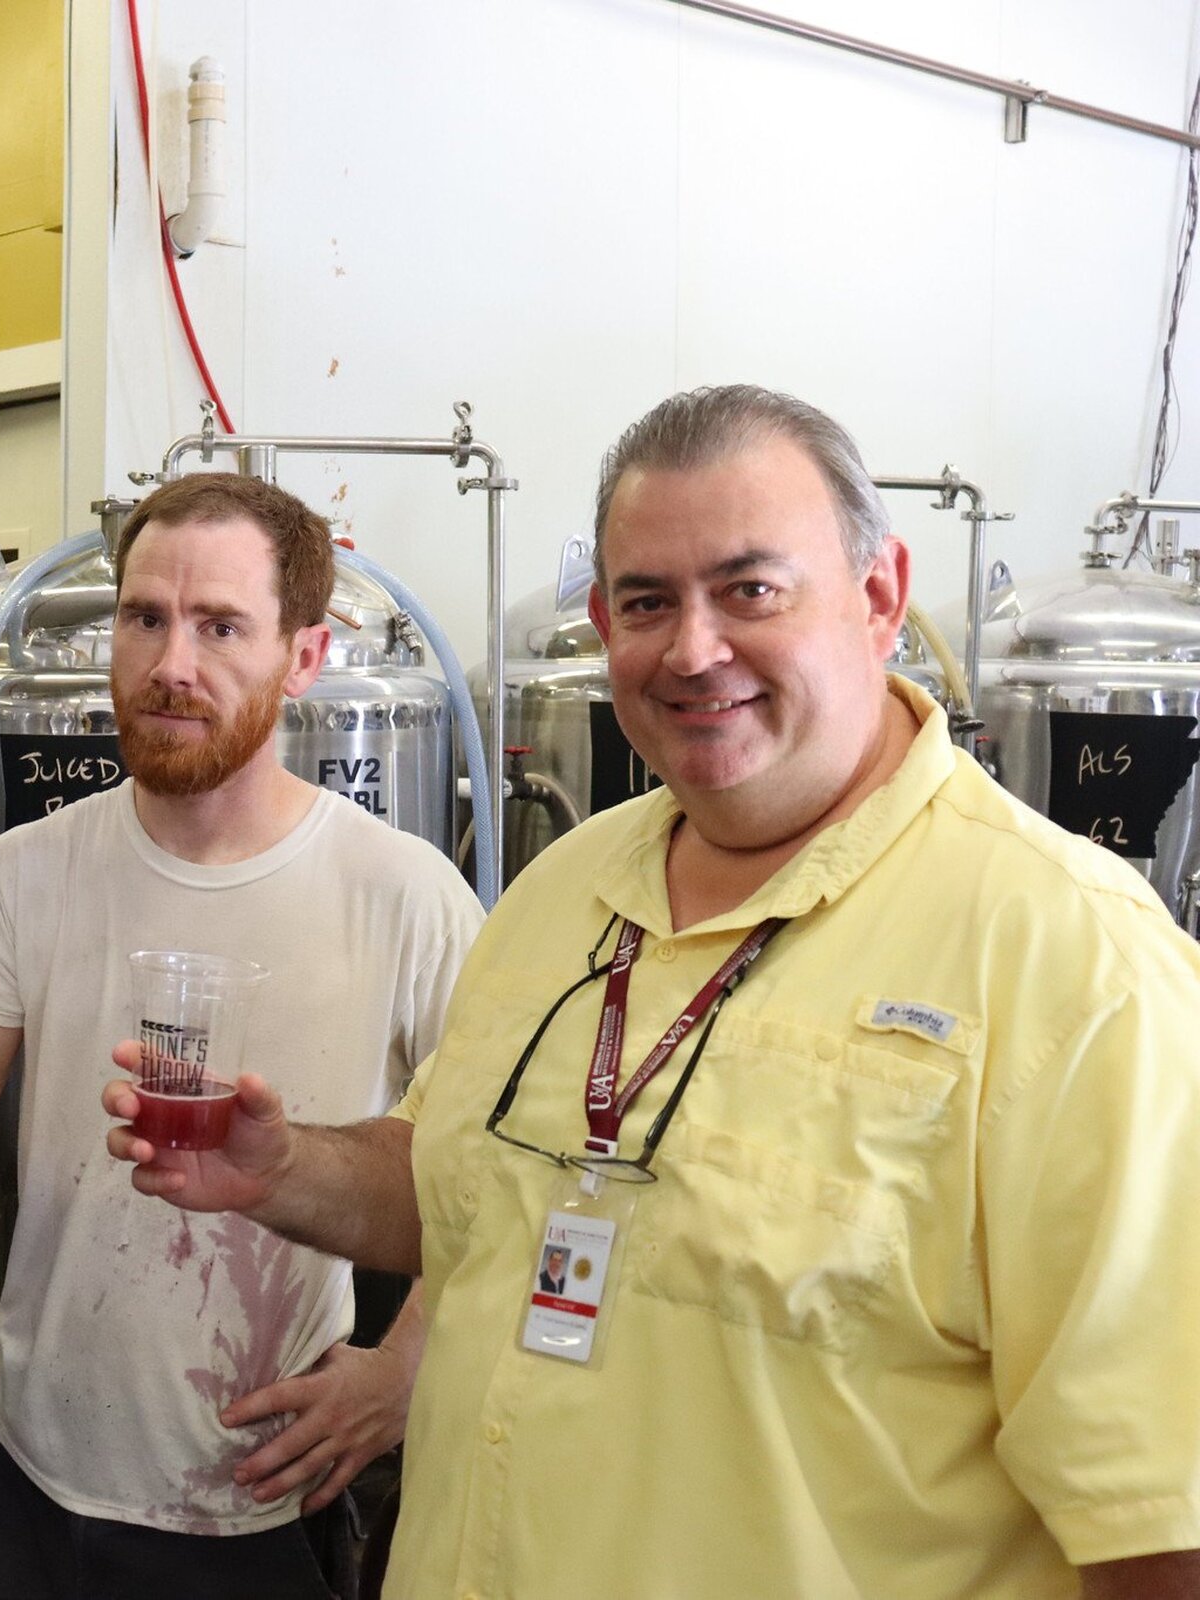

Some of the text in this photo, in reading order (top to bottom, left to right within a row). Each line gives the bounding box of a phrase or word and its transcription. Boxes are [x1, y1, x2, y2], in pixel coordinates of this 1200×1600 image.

[19, 751, 120, 785] JUICED
[318, 758, 381, 785] FV2
[338, 790, 387, 815] BL
[140, 1029, 208, 1063] STONE'S
[141, 1055, 205, 1092] THROW
